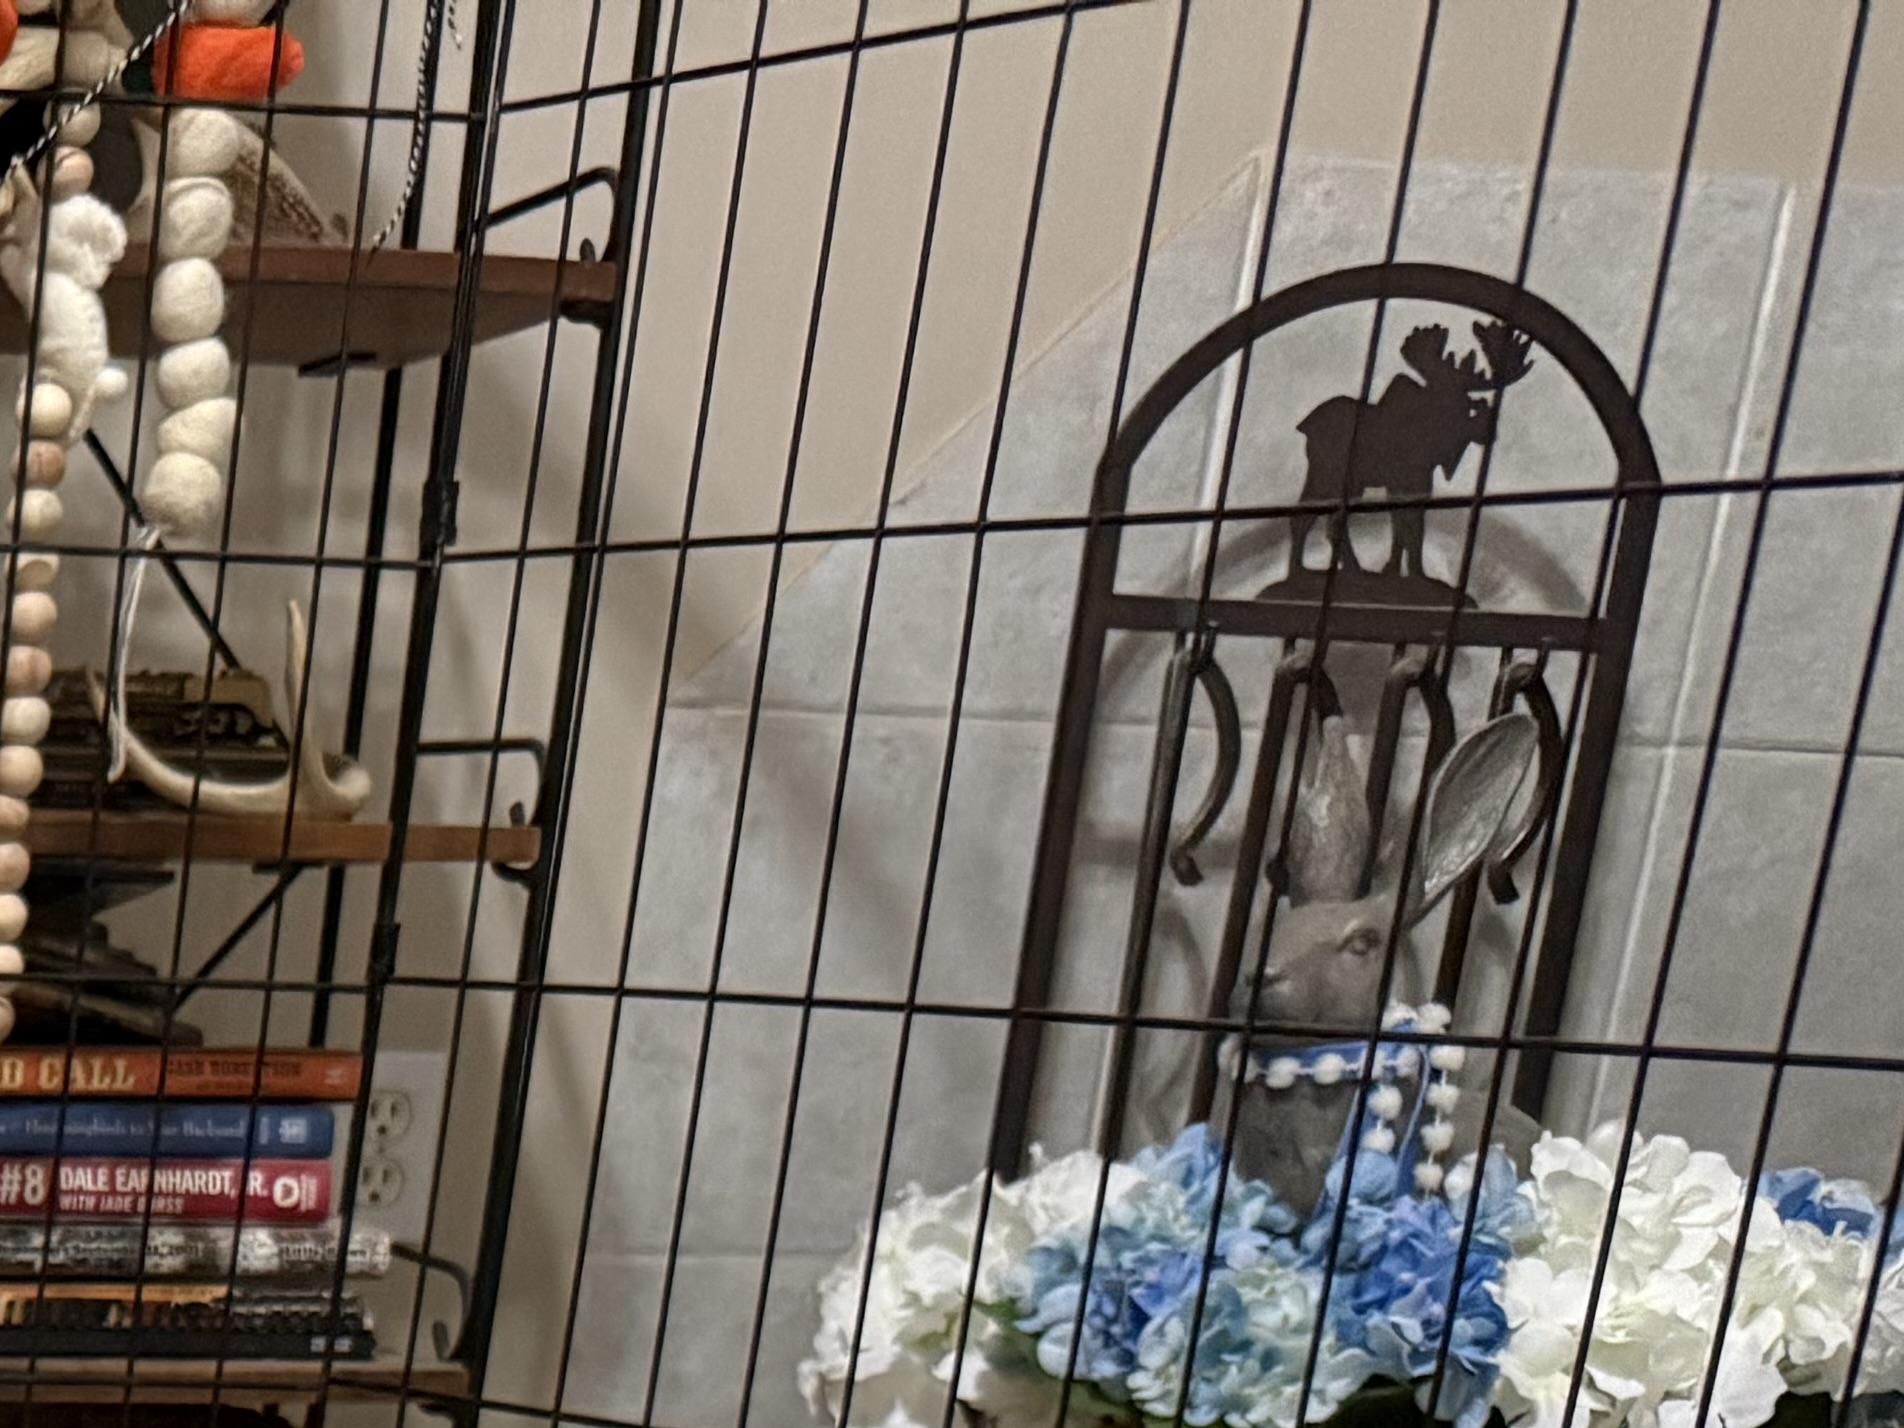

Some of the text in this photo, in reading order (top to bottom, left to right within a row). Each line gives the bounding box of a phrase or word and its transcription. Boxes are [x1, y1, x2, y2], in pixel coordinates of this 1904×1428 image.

[37, 1056, 136, 1091] CALL
[59, 1165, 110, 1193] DALE
[59, 1194, 93, 1213] WITH
